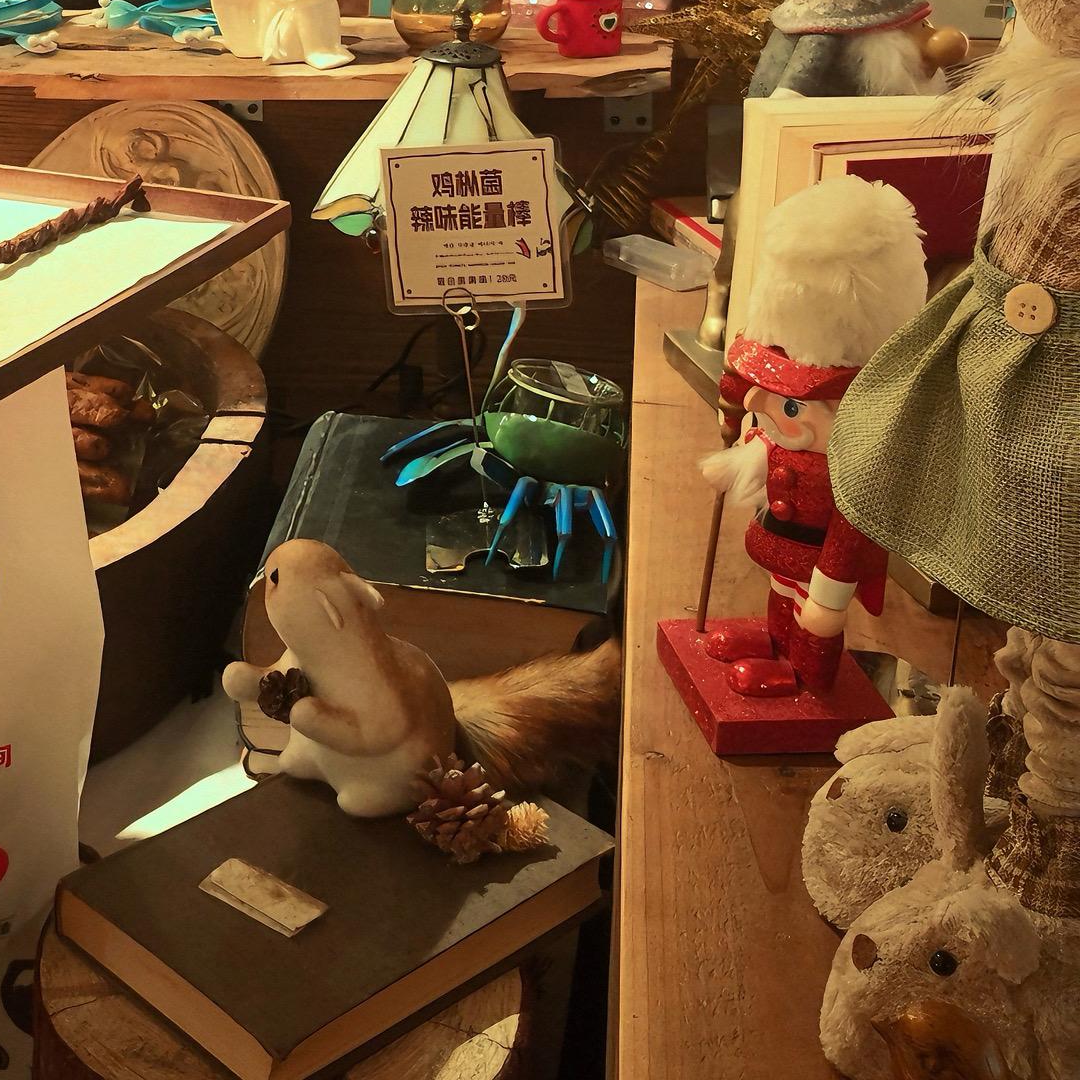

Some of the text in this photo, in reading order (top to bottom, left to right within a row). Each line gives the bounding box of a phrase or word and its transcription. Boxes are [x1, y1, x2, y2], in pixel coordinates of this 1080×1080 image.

[431, 168, 503, 198] 鸡枞菌
[410, 200, 532, 232] 辣味能量棒
